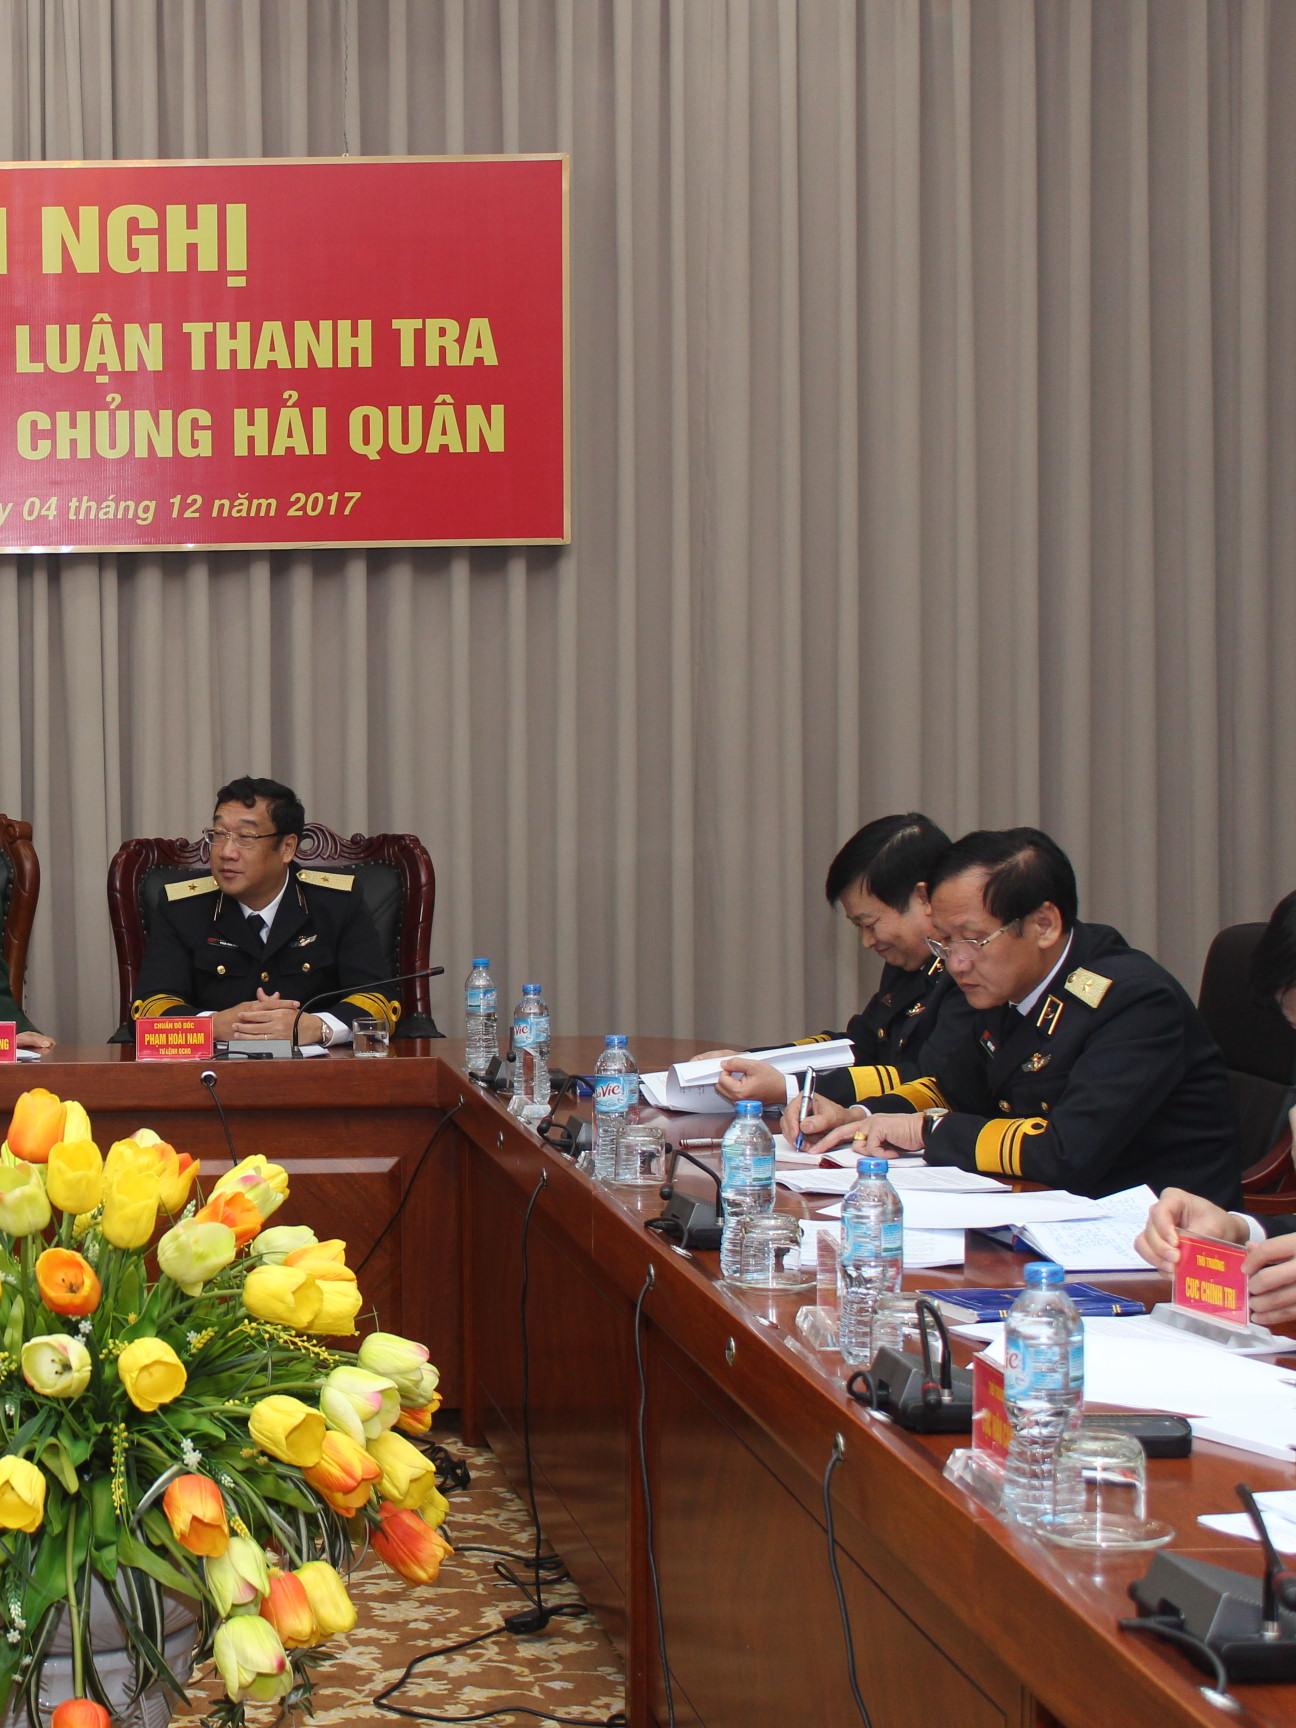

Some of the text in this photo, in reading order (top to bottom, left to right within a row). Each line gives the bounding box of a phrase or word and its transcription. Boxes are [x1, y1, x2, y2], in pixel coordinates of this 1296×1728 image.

[41, 204, 248, 288] NGHỊ
[16, 313, 163, 383] LUẬN
[182, 320, 373, 371] THANH
[392, 318, 499, 367] TRA
[16, 393, 213, 459] CHỦNG
[234, 391, 327, 457] HẢI
[348, 395, 505, 460] QUÂN
[22, 496, 58, 521] 04
[68, 494, 157, 526] tháng
[170, 494, 203, 518] 12
[211, 493, 278, 518] năm
[287, 491, 362, 516] 2017
[144, 1030, 204, 1048] PHẠM HOÀI NAM
[1185, 1276, 1200, 1303] CỤC
